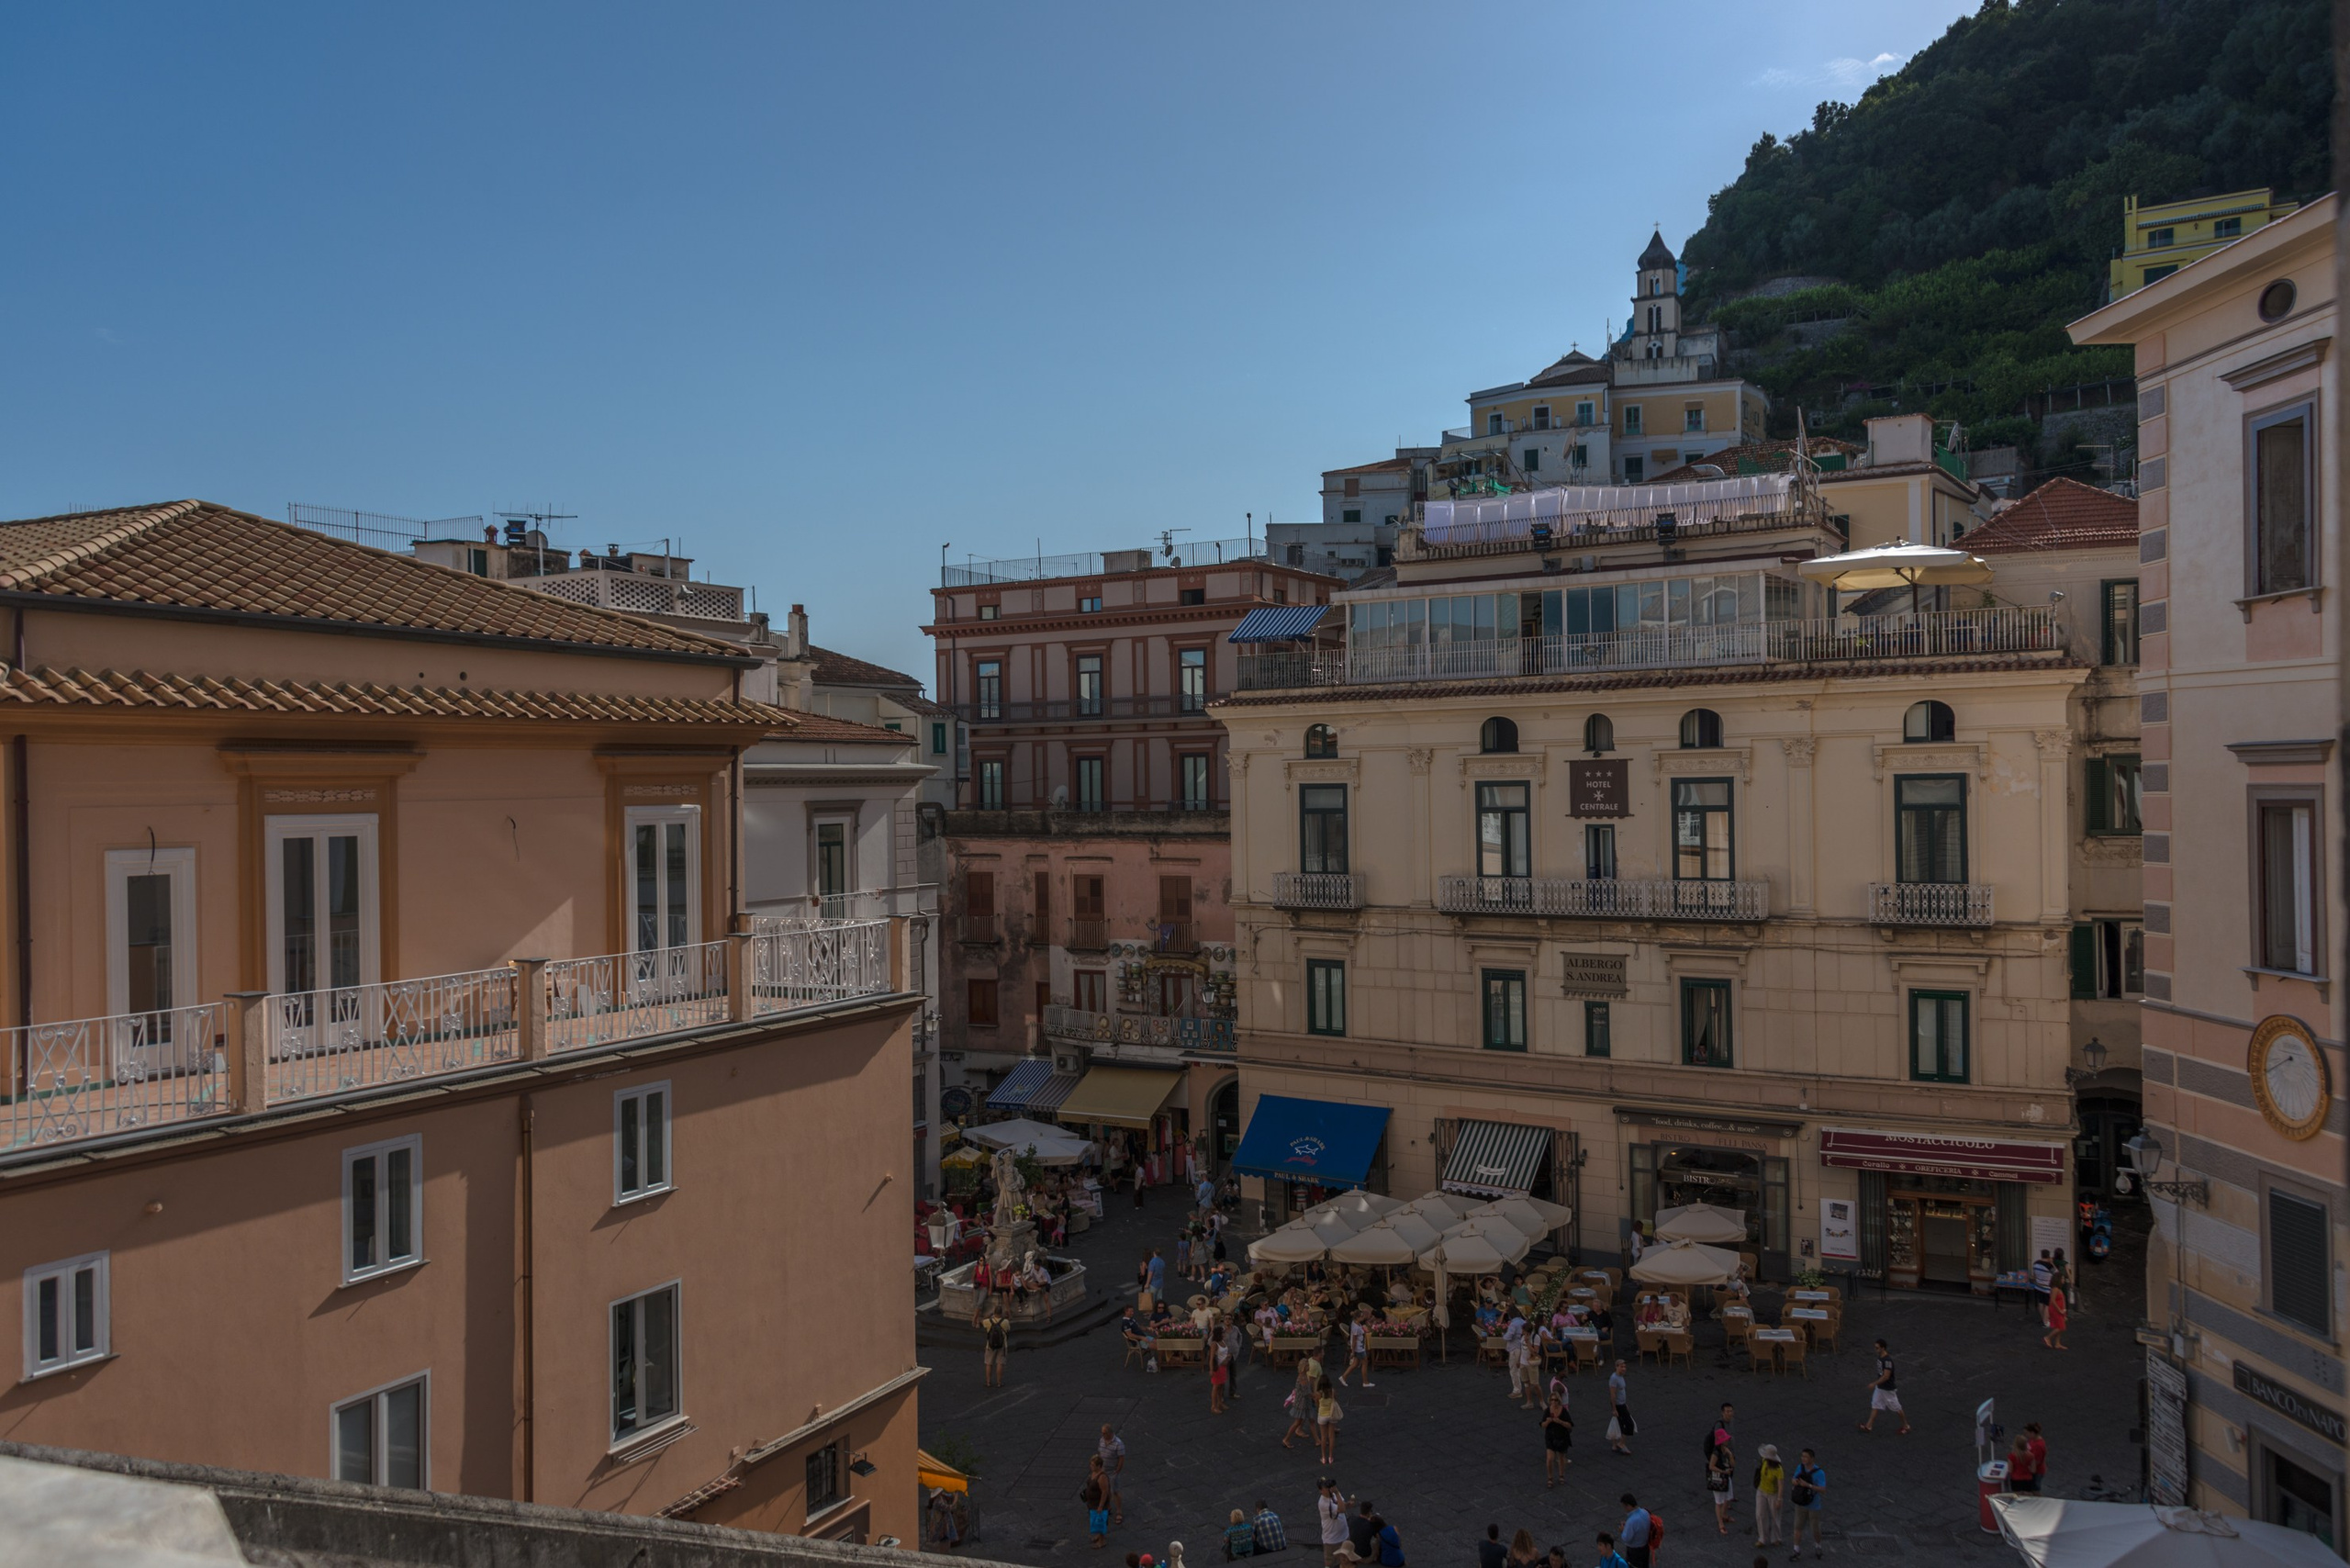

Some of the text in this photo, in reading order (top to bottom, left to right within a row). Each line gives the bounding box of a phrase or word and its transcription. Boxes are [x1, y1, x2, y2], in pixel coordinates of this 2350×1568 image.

[1567, 958, 1623, 970] ALBERGO
[1660, 1133, 1691, 1143] BISTRO
[1741, 1140, 1769, 1150] PANSA
[1862, 1160, 1891, 1169] Corallo
[1914, 1165, 1963, 1175] OREFICERIA
[1274, 1171, 1291, 1181] PAUL
[1298, 1175, 1320, 1184] SHARK
[1684, 1175, 1717, 1184] BISTRO
[2252, 1377, 2297, 1414] BANCO
